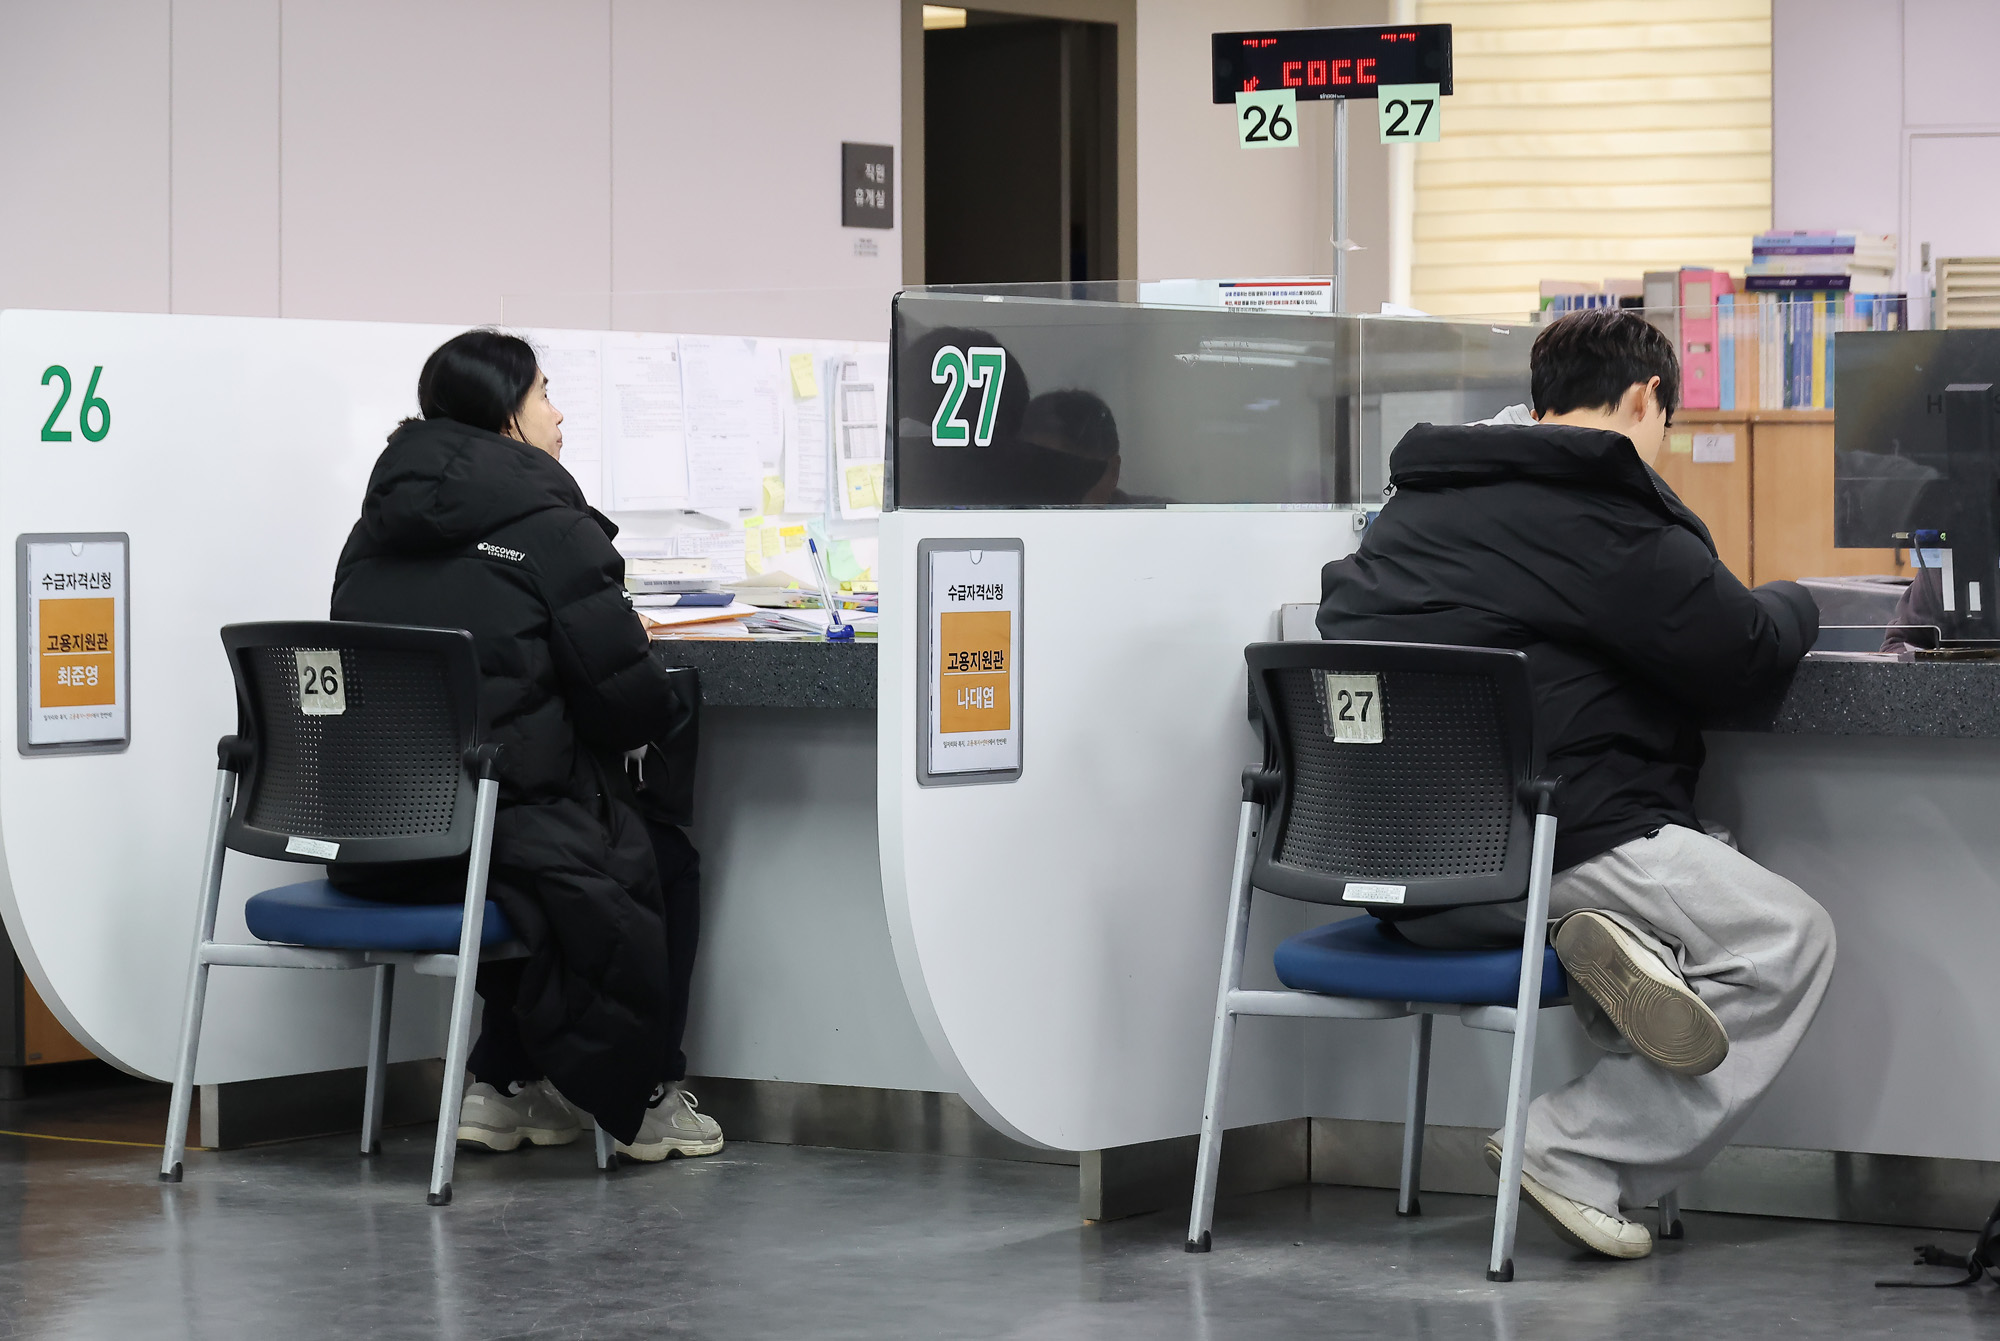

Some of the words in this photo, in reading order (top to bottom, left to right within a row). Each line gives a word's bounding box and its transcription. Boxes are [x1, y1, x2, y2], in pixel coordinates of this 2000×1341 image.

[1242, 104, 1293, 143] 26
[1384, 98, 1435, 137] 27
[865, 163, 885, 184] 직원
[41, 364, 111, 442] 26
[932, 345, 1006, 447] 27
[42, 572, 112, 591] 수급자격신청
[948, 583, 1004, 601] 수급자격신청
[46, 632, 109, 652] 고용지원관
[947, 650, 1004, 672] 고용지원관
[57, 664, 99, 687] 최준영
[303, 665, 339, 696] 26
[957, 686, 995, 710] 나대엽
[1337, 689, 1374, 722] 27
